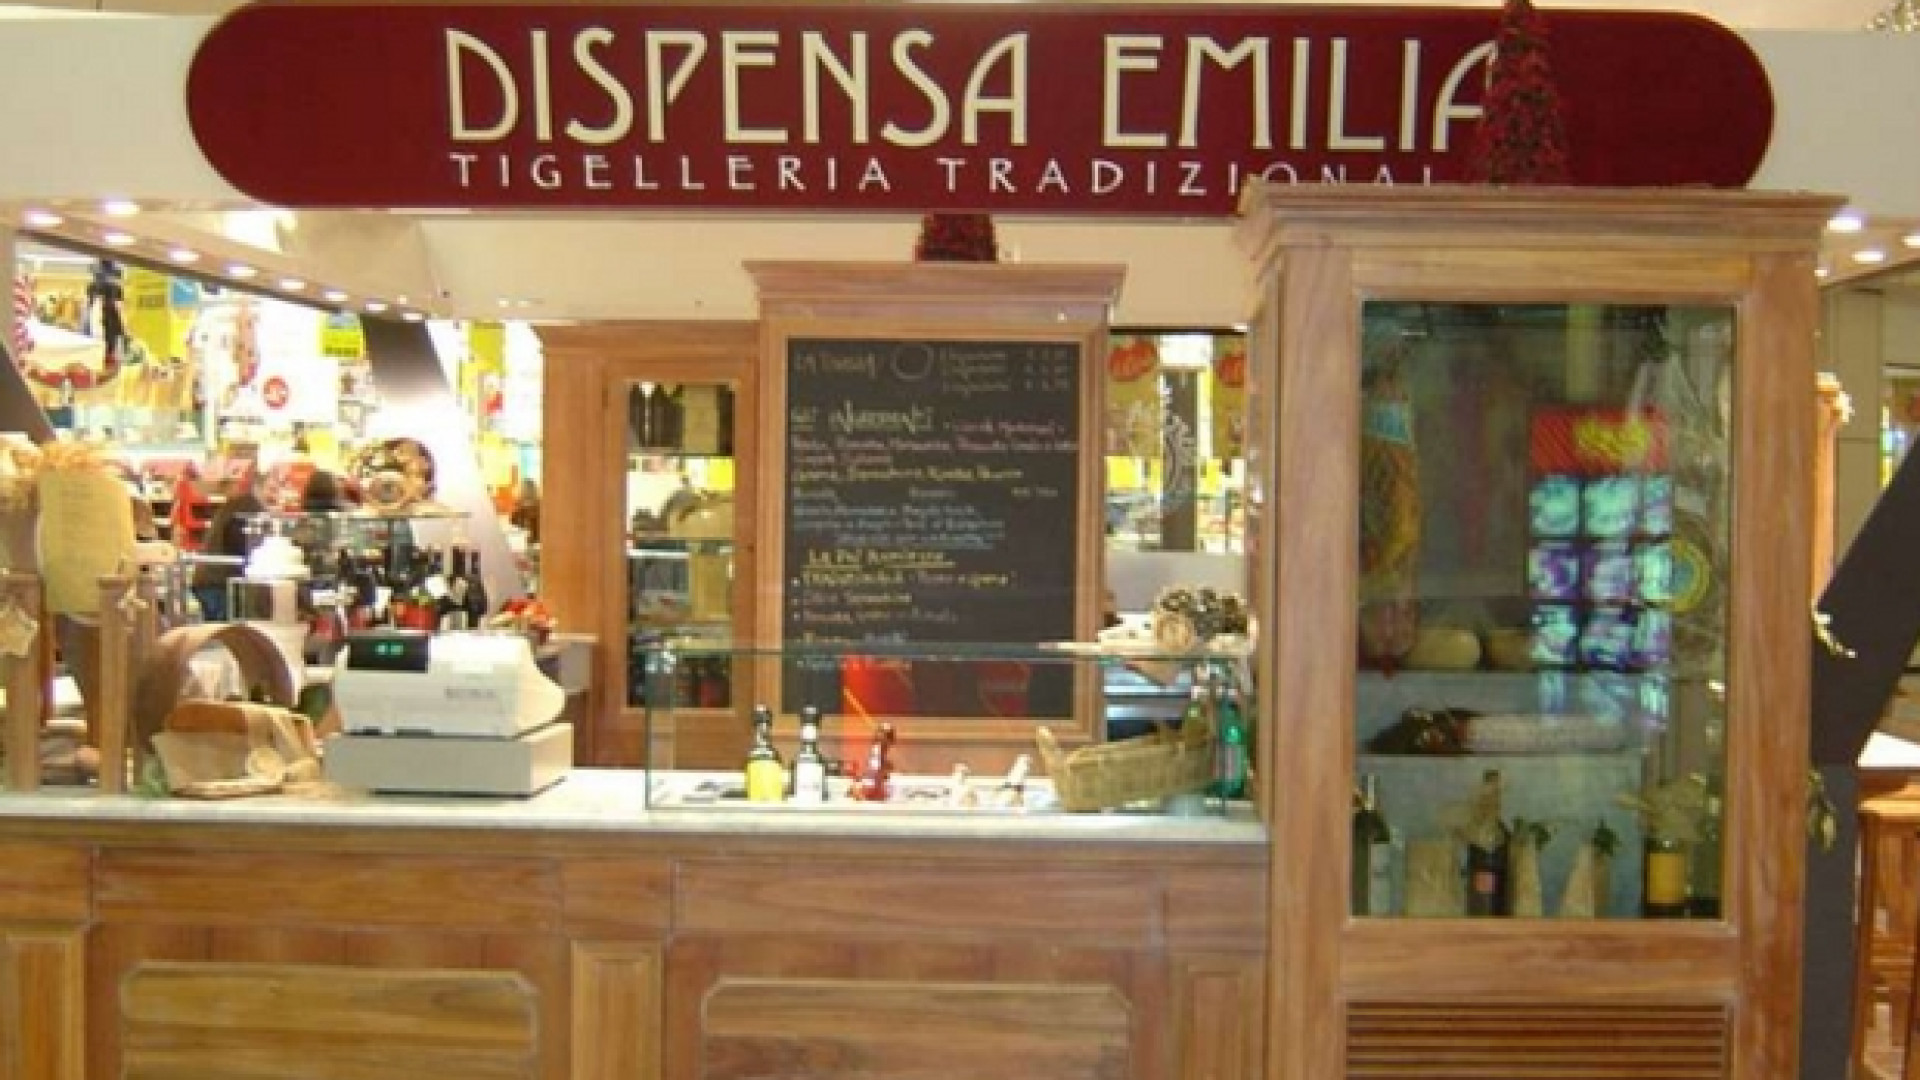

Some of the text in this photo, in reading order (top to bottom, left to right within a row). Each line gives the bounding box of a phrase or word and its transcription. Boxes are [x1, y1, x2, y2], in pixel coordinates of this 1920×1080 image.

[445, 26, 1499, 153] DISPENSA EMILIA
[449, 152, 891, 193] TIGELLERIA
